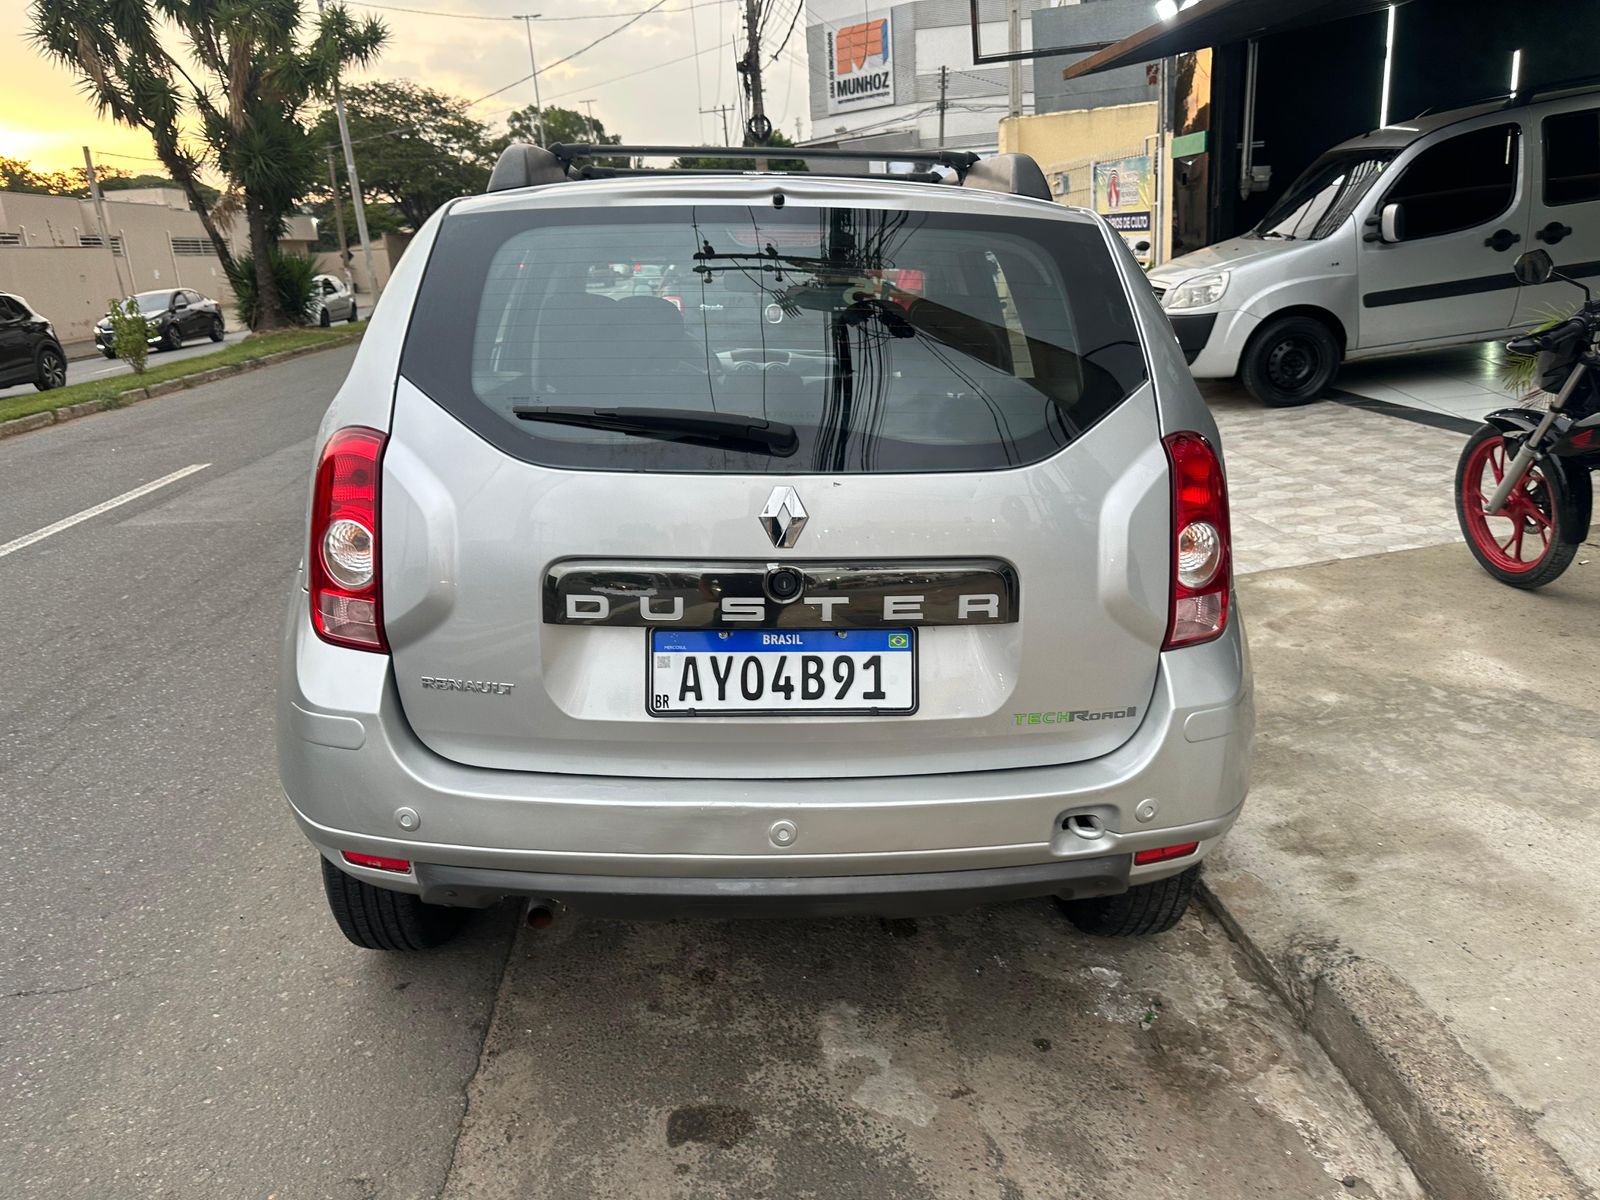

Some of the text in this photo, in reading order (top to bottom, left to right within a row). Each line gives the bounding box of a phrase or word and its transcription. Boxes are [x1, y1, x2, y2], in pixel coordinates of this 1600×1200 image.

[837, 72, 890, 97] MUNHOZ
[1123, 216, 1131, 229] DE
[1131, 215, 1148, 229] CULTO
[565, 593, 1000, 621] DUSTER
[763, 634, 804, 645] BRASIL
[420, 676, 515, 696] RENAULT
[655, 694, 670, 709] BR
